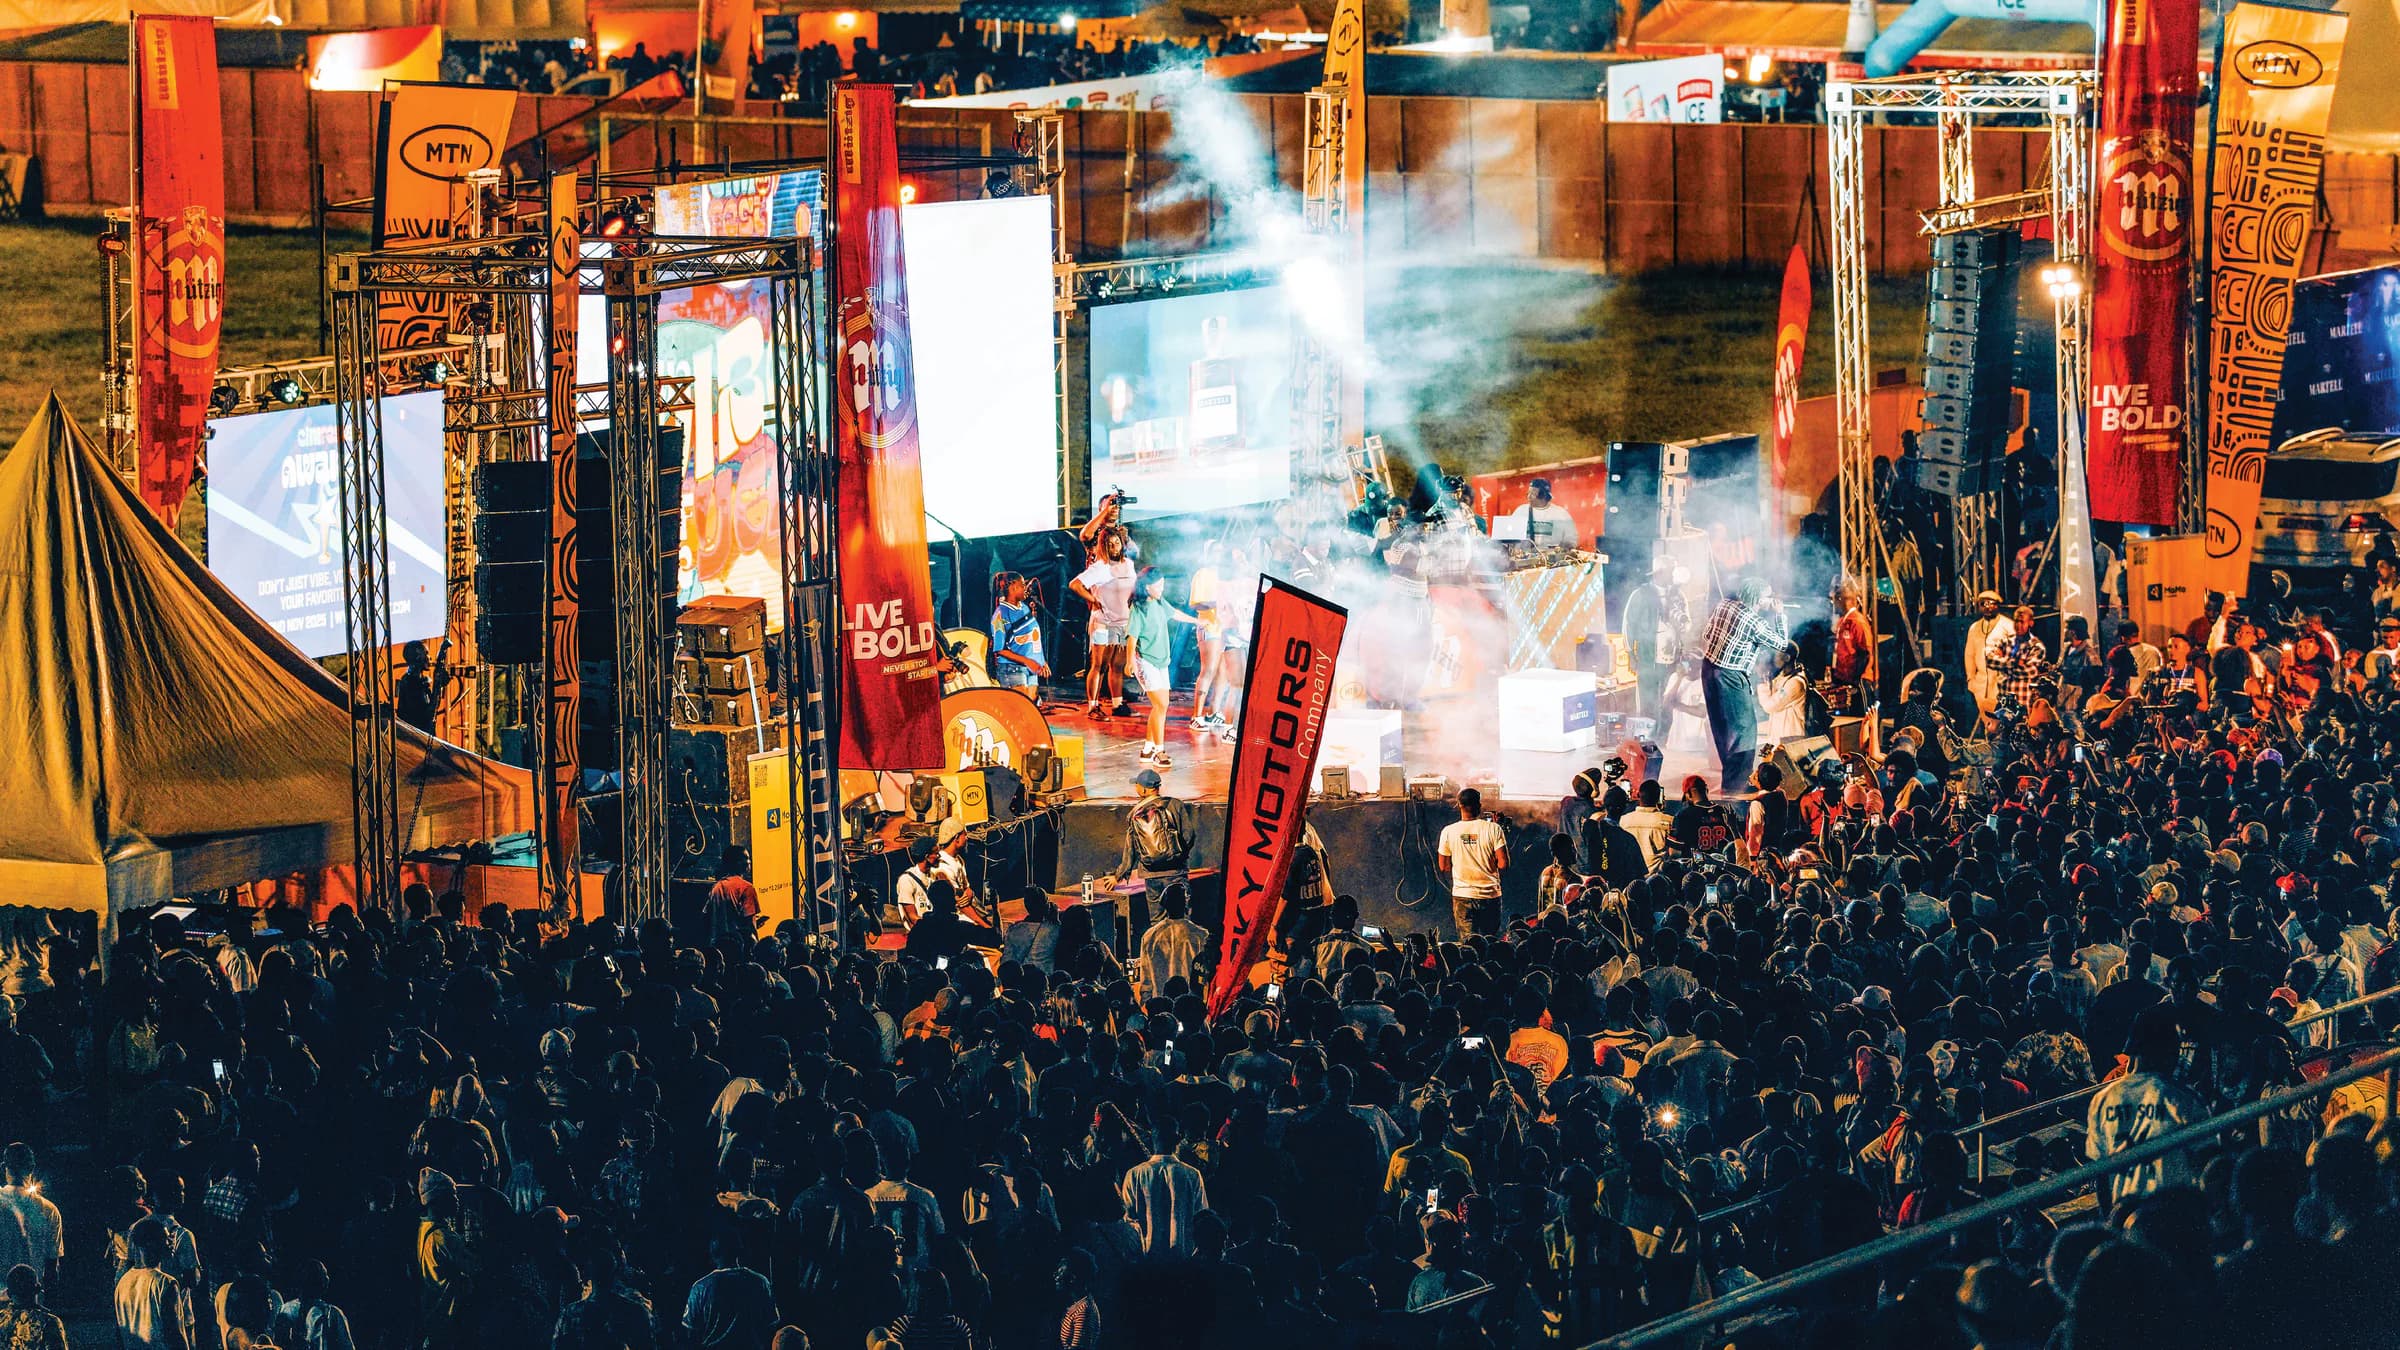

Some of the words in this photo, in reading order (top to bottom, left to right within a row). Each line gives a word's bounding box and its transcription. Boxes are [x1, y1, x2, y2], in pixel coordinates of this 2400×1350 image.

[2252, 56, 2300, 77] MTN
[1685, 102, 1705, 122] ICE
[425, 142, 473, 164] MTN
[2286, 331, 2306, 346] TELL
[2330, 321, 2362, 338] MARTELL
[2092, 384, 2149, 408] LIVE
[2309, 379, 2343, 396] MARTELL
[2101, 405, 2182, 432] BOLD
[2208, 525, 2226, 545] TN
[258, 577, 285, 596] DON'T
[285, 575, 308, 592] JUST
[281, 591, 305, 611] YOUR
[842, 598, 904, 631] LIVE
[853, 621, 934, 660] BOLD
[1297, 647, 1333, 760] Company
[1247, 636, 1313, 861] MOTORS
[966, 790, 979, 800] MTN
